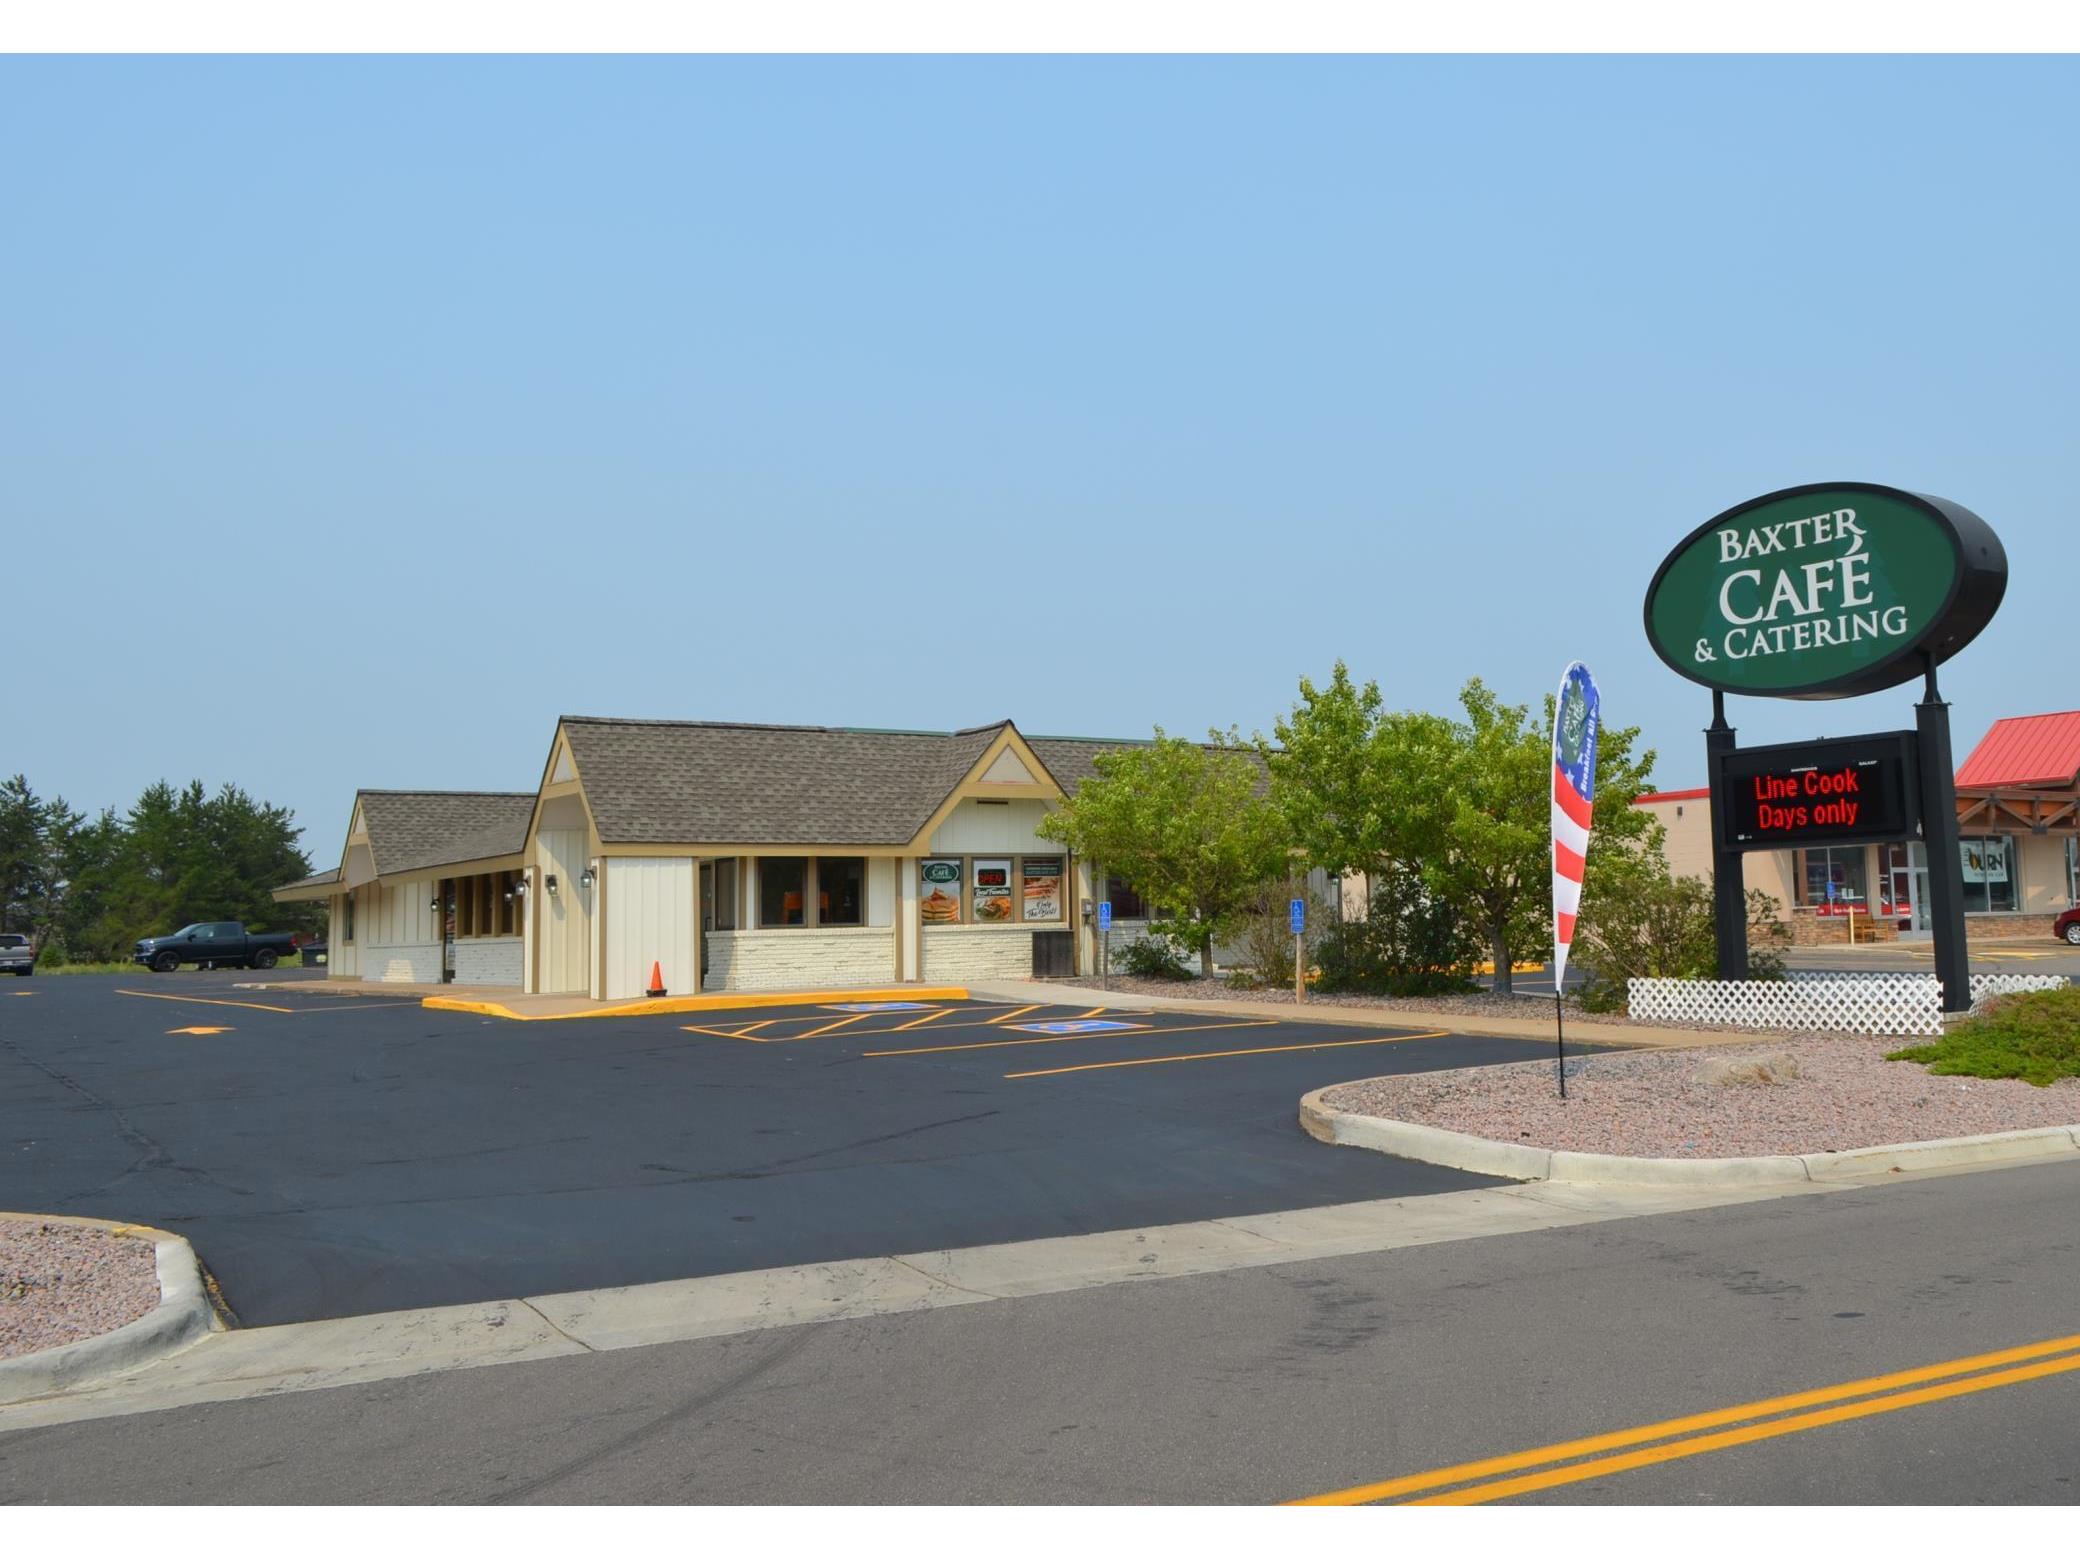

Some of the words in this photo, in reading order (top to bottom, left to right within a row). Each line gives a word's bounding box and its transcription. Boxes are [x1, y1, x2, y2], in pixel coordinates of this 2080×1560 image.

[1718, 509, 1866, 562] BAXTER
[1719, 534, 1874, 626] CAFÉ
[1694, 637, 1718, 662] &
[1723, 605, 1909, 660] CATERING
[1580, 737, 1593, 793] Breakfast
[1754, 774, 1798, 800] Line
[1804, 768, 1859, 796] Cook
[1758, 804, 1807, 831] Days
[1814, 798, 1859, 826] only
